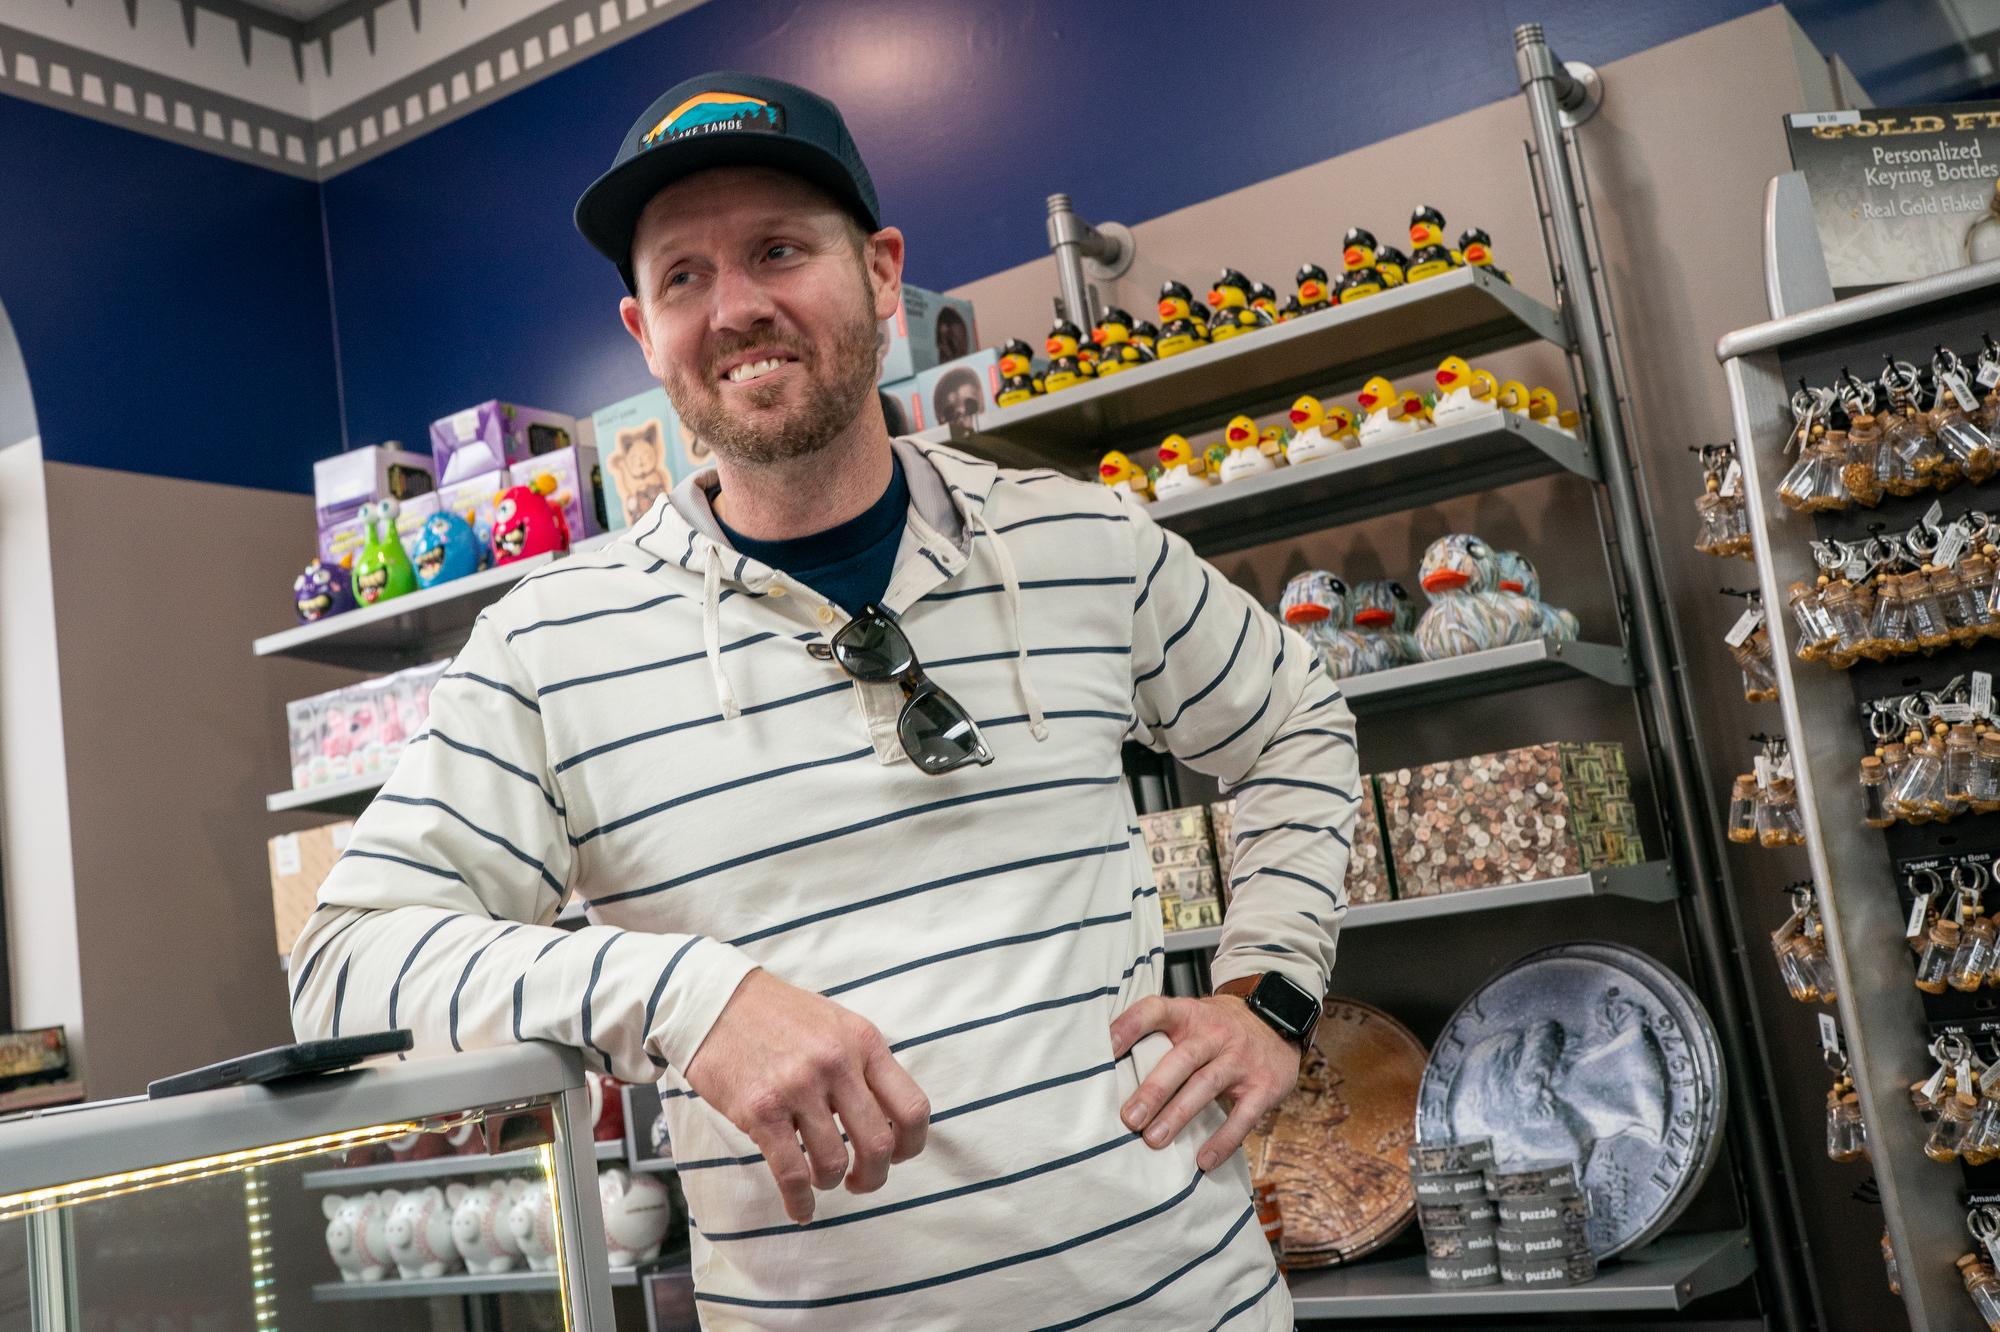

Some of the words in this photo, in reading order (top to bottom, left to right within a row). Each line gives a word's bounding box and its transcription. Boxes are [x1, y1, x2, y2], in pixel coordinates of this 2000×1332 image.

[703, 119, 743, 133] TAHOE
[1811, 114, 1946, 139] GOLD
[1872, 137, 1983, 165] Personalized
[1864, 165, 1934, 190] Keyring
[1936, 159, 1999, 182] Bottles
[1862, 202, 1896, 219] Real
[1900, 197, 1938, 217] Gold
[1968, 854, 1990, 862] Boss
[1520, 1206, 1558, 1223] puzzle
[1525, 1236, 1563, 1254] puzzle
[1462, 1263, 1498, 1281] puzzle
[1525, 1266, 1563, 1284] puzzle
